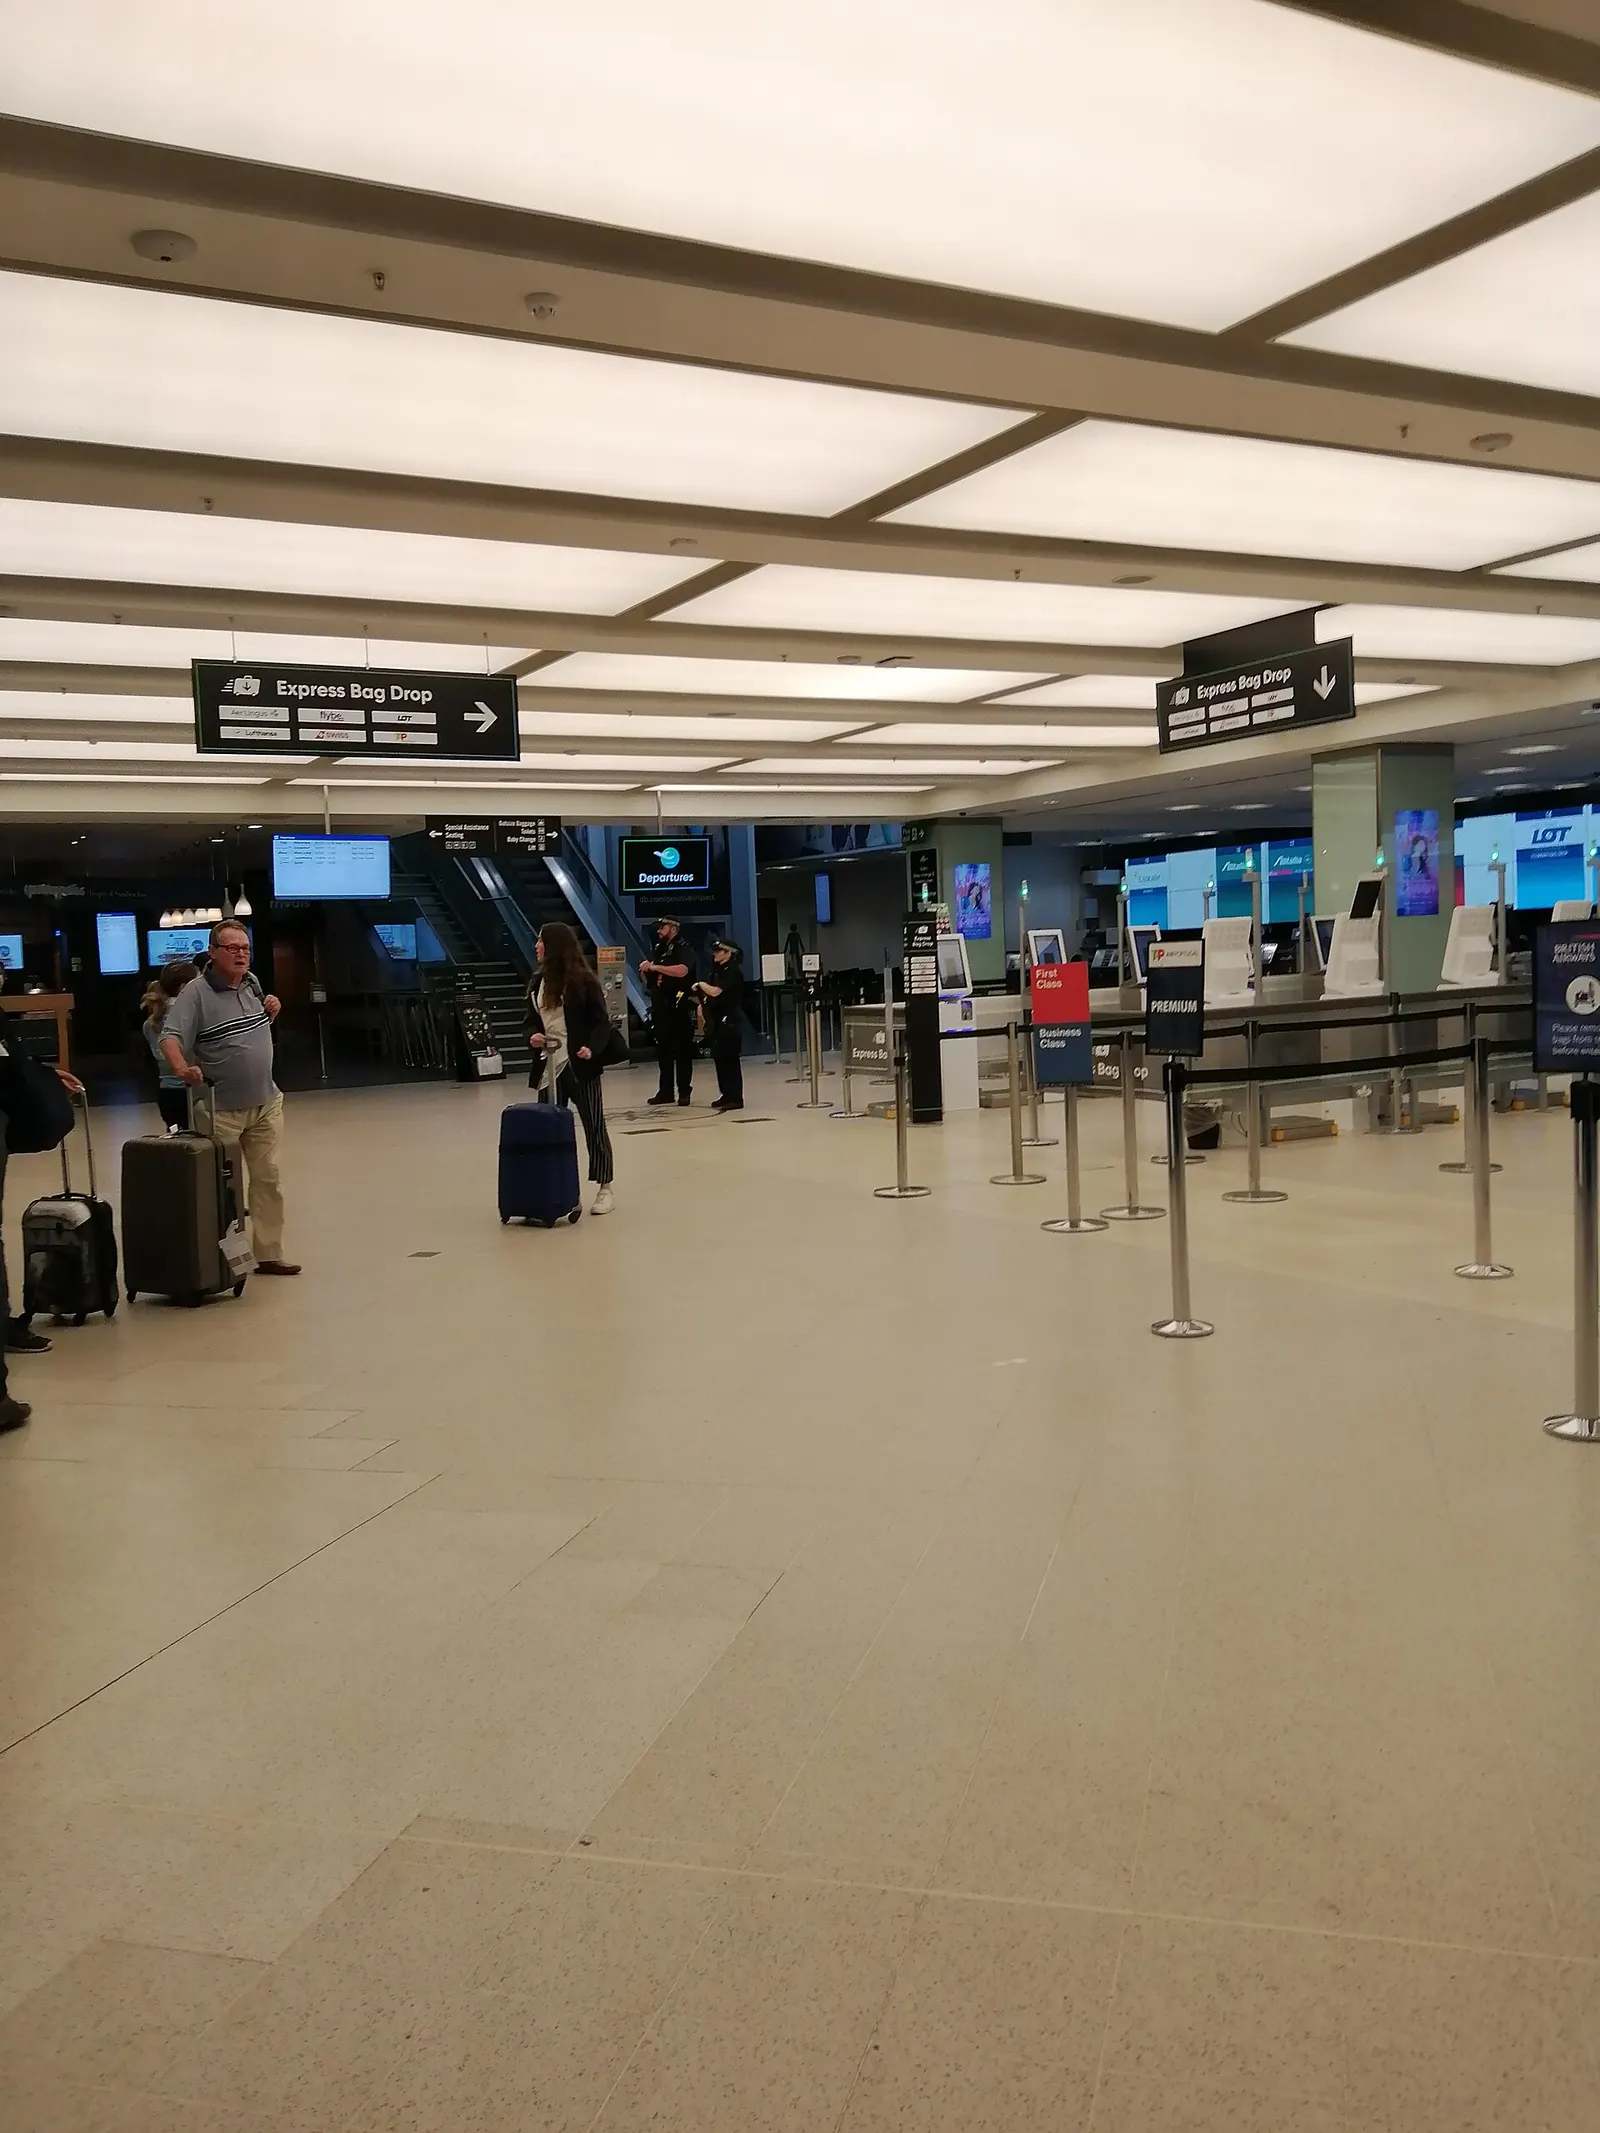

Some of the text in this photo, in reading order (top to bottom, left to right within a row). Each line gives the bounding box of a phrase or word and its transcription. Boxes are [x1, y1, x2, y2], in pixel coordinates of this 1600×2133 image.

[1197, 667, 1292, 700] Express Bag Drop
[277, 680, 433, 705] Express Bag Drop
[445, 824, 463, 832] Special
[516, 820, 536, 828] Baggage
[507, 836, 518, 844] Baby
[1531, 826, 1573, 844] LOT
[638, 873, 694, 885] Departures
[1554, 942, 1596, 953] BRITISH
[1552, 953, 1596, 963] AIRWAYS
[1035, 968, 1058, 979] First
[1036, 978, 1063, 989] Class
[1151, 1000, 1198, 1013] PREMIUM
[1039, 1027, 1082, 1039] Business
[1552, 1022, 1579, 1033] Please
[1040, 1039, 1067, 1050] Class
[1552, 1034, 1572, 1045] bags
[1572, 1034, 1593, 1044] from
[852, 1047, 888, 1060] Express Ba
[1552, 1045, 1579, 1056] before
[1097, 1062, 1120, 1079] Bag
[1134, 1066, 1149, 1081] op
